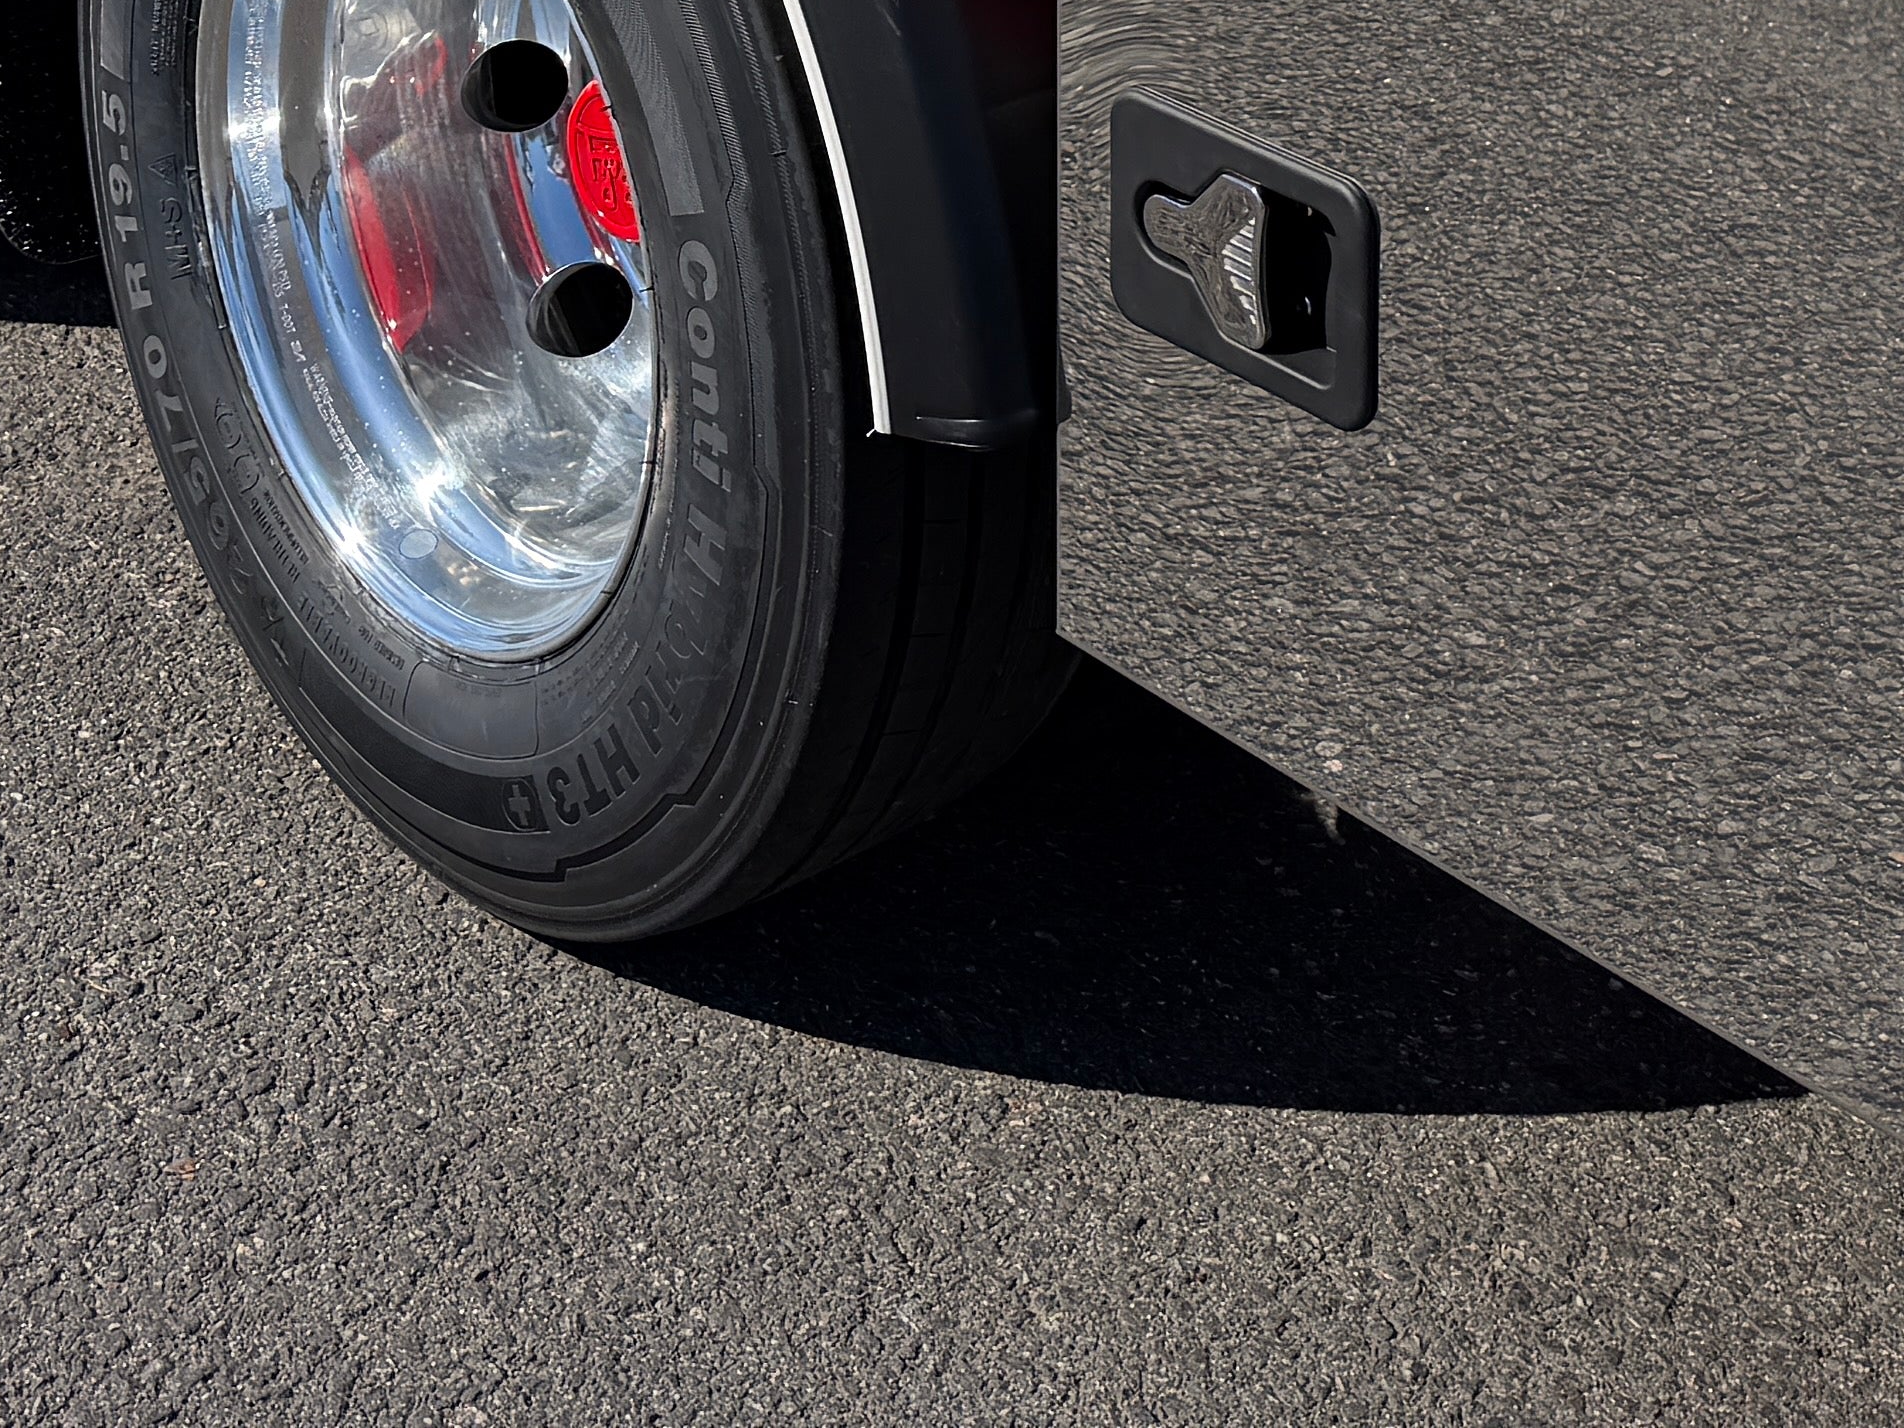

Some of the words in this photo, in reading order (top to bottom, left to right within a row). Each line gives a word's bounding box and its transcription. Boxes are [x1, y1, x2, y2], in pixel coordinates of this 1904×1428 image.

[100, 88, 141, 233] 19.5
[129, 260, 153, 311] R
[674, 237, 736, 494] Conti
[142, 334, 254, 597] 265/70
[627, 502, 728, 758] Hybrid
[546, 722, 641, 827] HT3
